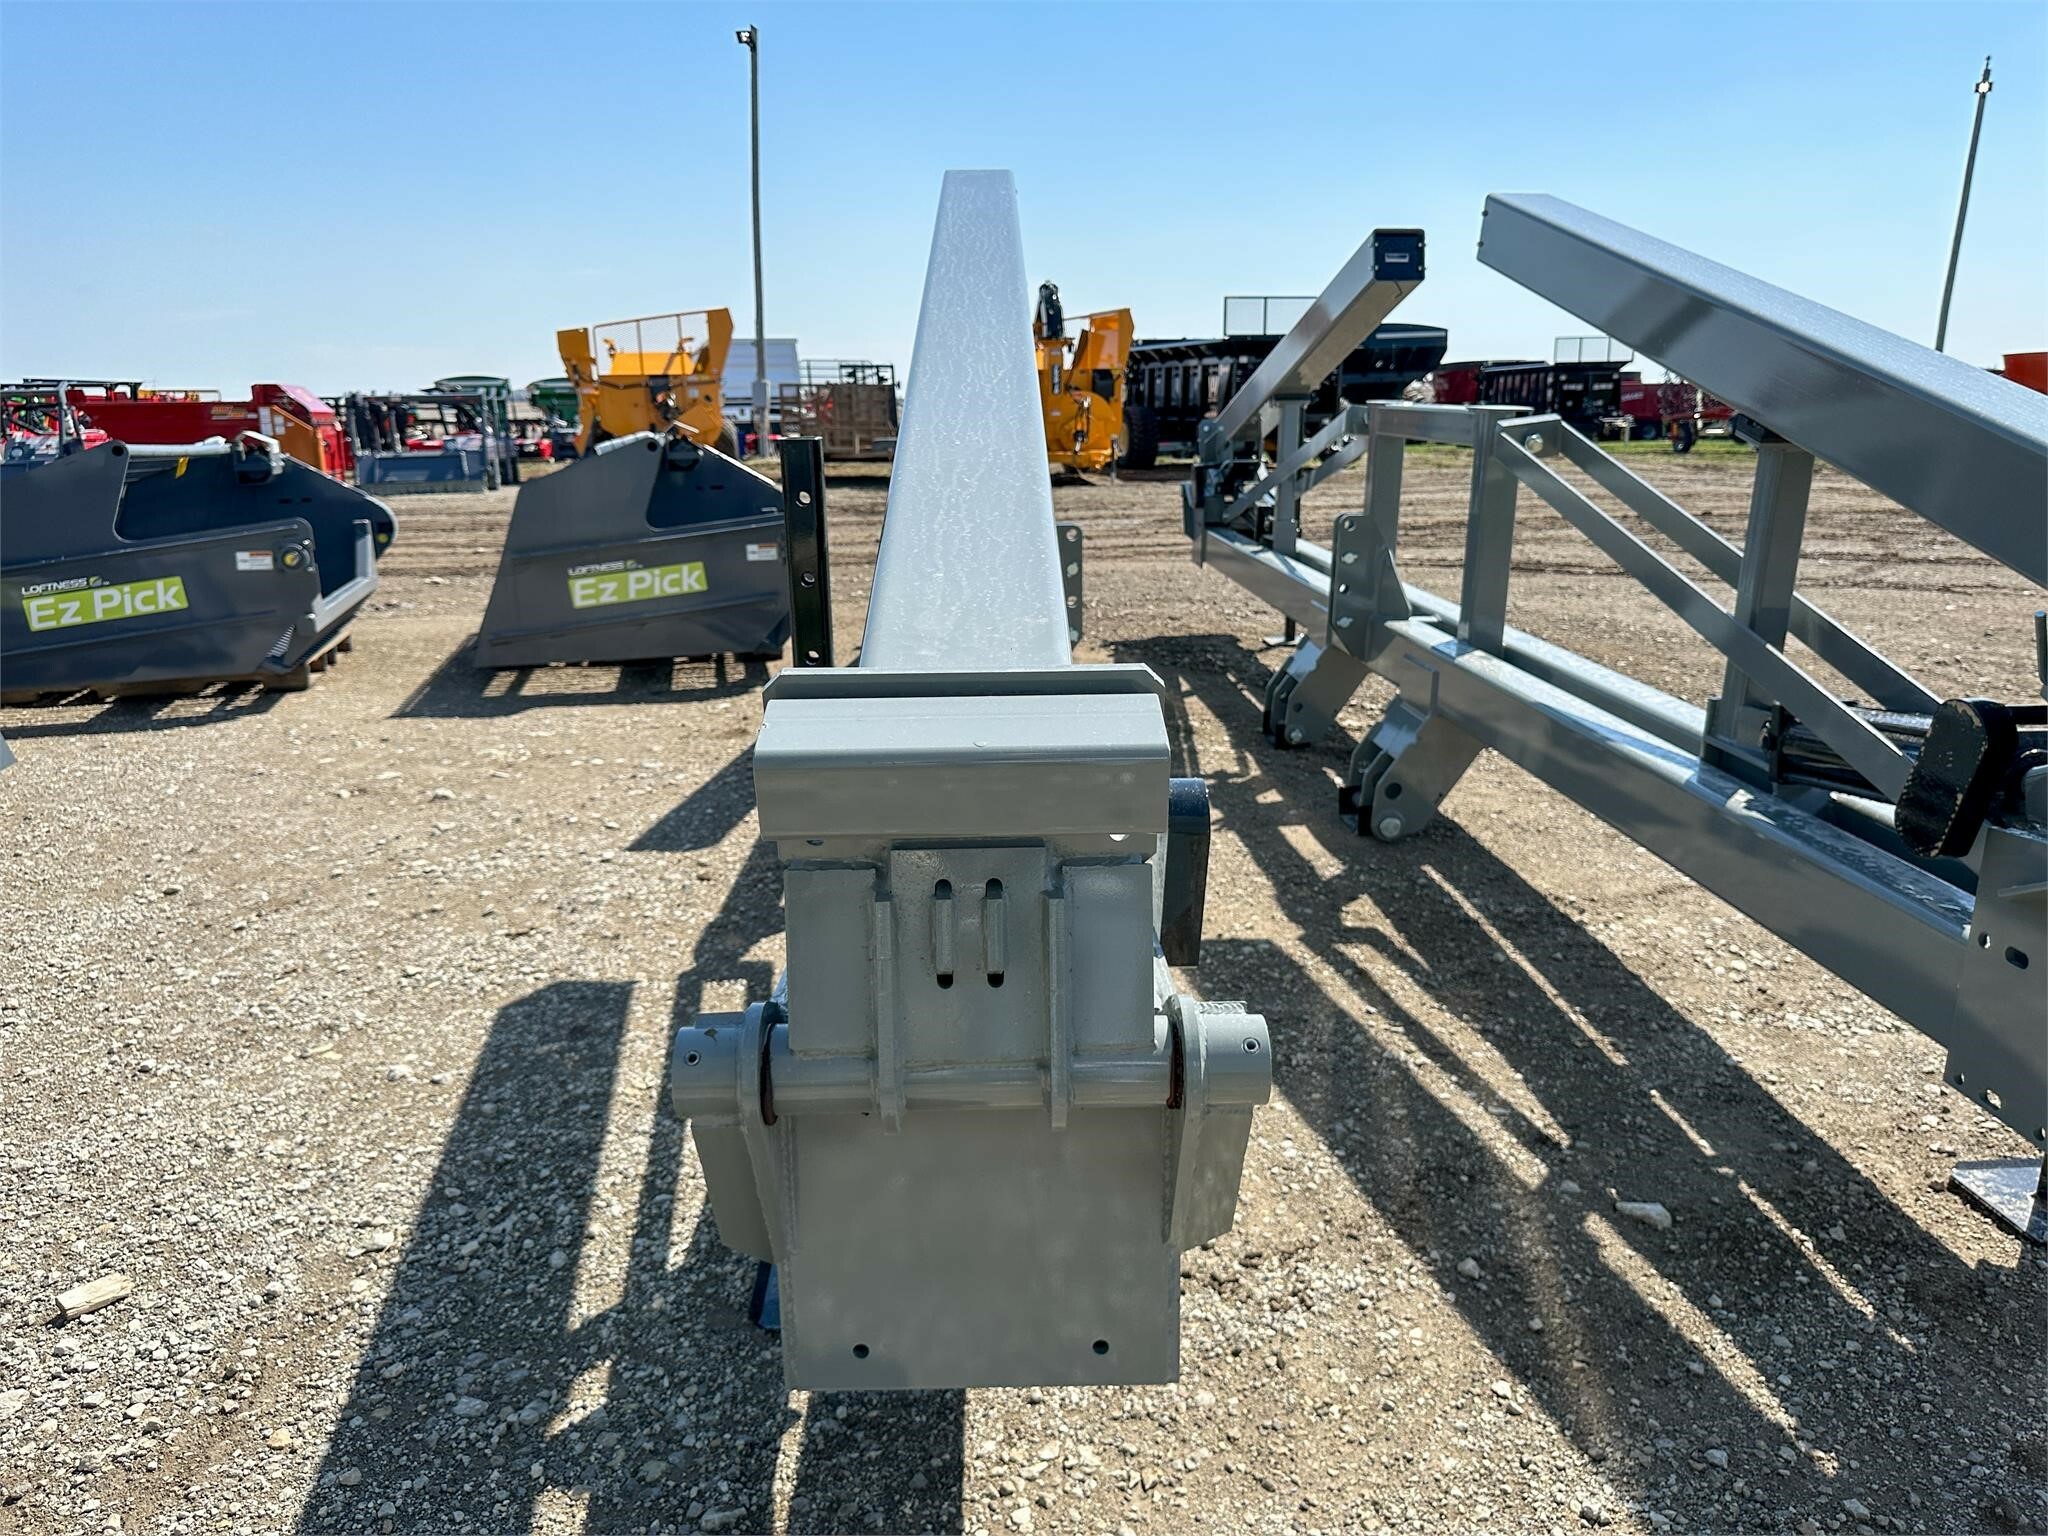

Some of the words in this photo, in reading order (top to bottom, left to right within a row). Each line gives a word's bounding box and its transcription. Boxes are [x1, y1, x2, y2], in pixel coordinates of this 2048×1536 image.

[567, 560, 625, 576] LOFTNESS
[21, 577, 88, 595] LOFTNESS
[574, 578, 618, 606] Ez
[628, 565, 701, 599] Pick
[29, 597, 82, 628] Ez
[93, 580, 180, 620] Pick
